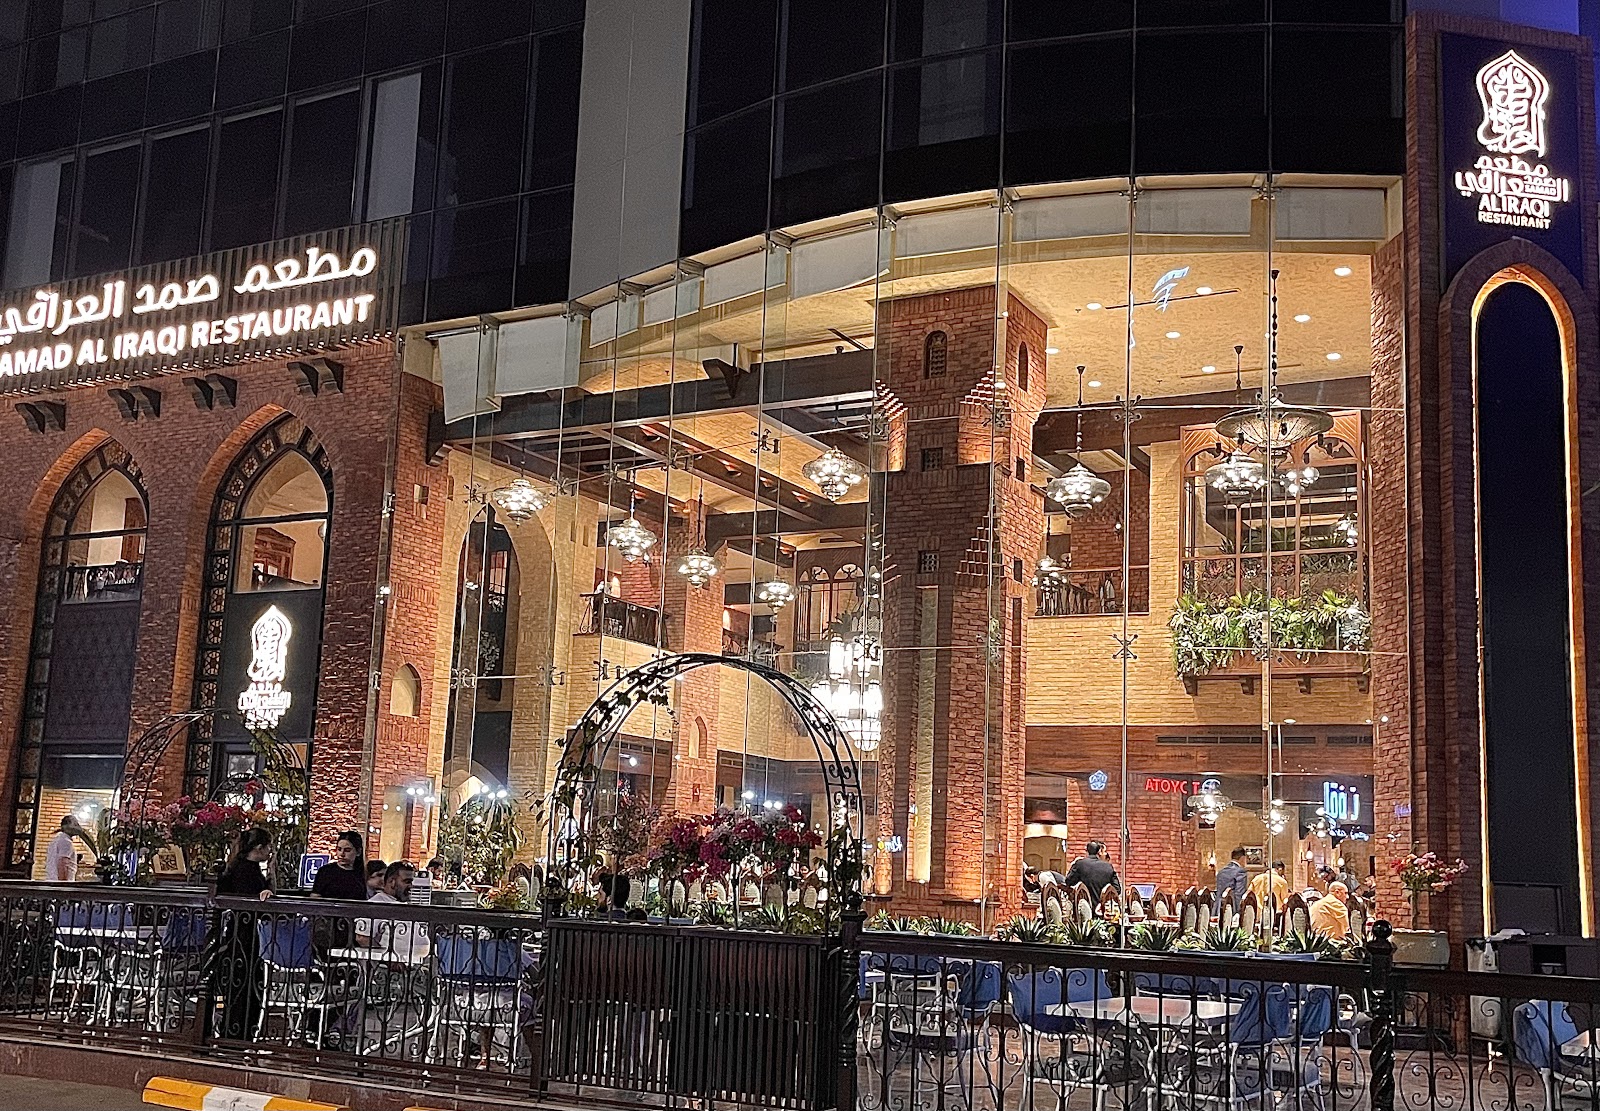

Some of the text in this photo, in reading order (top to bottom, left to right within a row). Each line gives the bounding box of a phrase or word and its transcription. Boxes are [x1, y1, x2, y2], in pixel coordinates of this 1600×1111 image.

[1473, 155, 1549, 178] مطعم
[1478, 211, 1552, 229] RESTAURANT
[234, 247, 377, 294] مطعم
[133, 274, 219, 314] صمد
[76, 338, 108, 366] AL
[113, 324, 187, 361] IRAQI
[191, 294, 375, 348] RESTAURANT
